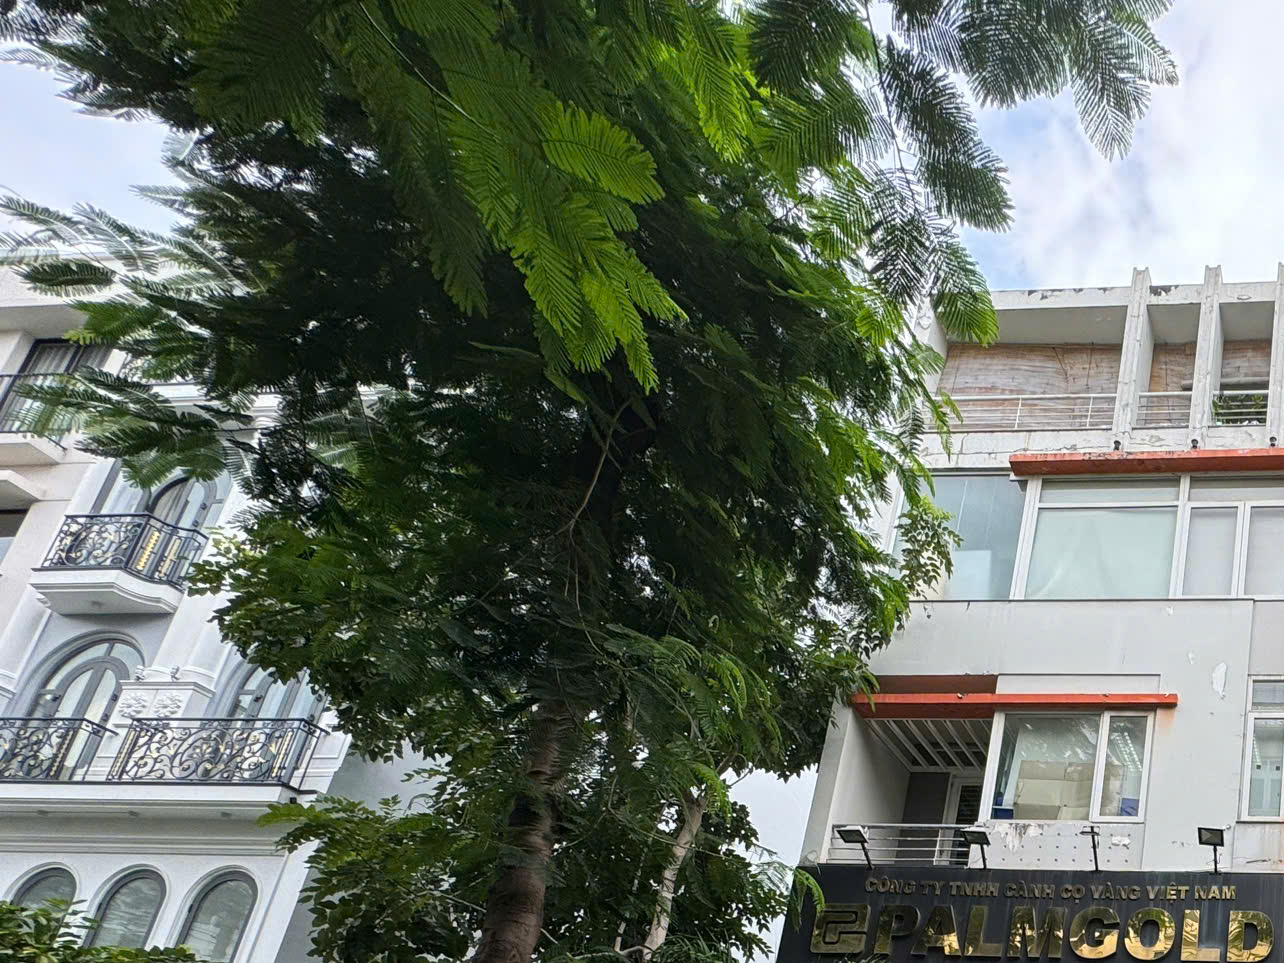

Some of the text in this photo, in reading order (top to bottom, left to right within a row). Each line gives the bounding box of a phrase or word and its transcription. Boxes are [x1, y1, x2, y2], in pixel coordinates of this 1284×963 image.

[865, 876, 916, 895] CÔNG
[920, 880, 945, 896] TY
[950, 881, 1000, 897] TNHH
[1091, 881, 1140, 900] VÀNG
[1147, 882, 1189, 903] VIỆT
[1194, 884, 1237, 901] NAM
[871, 904, 1275, 963] PALMGOLD
